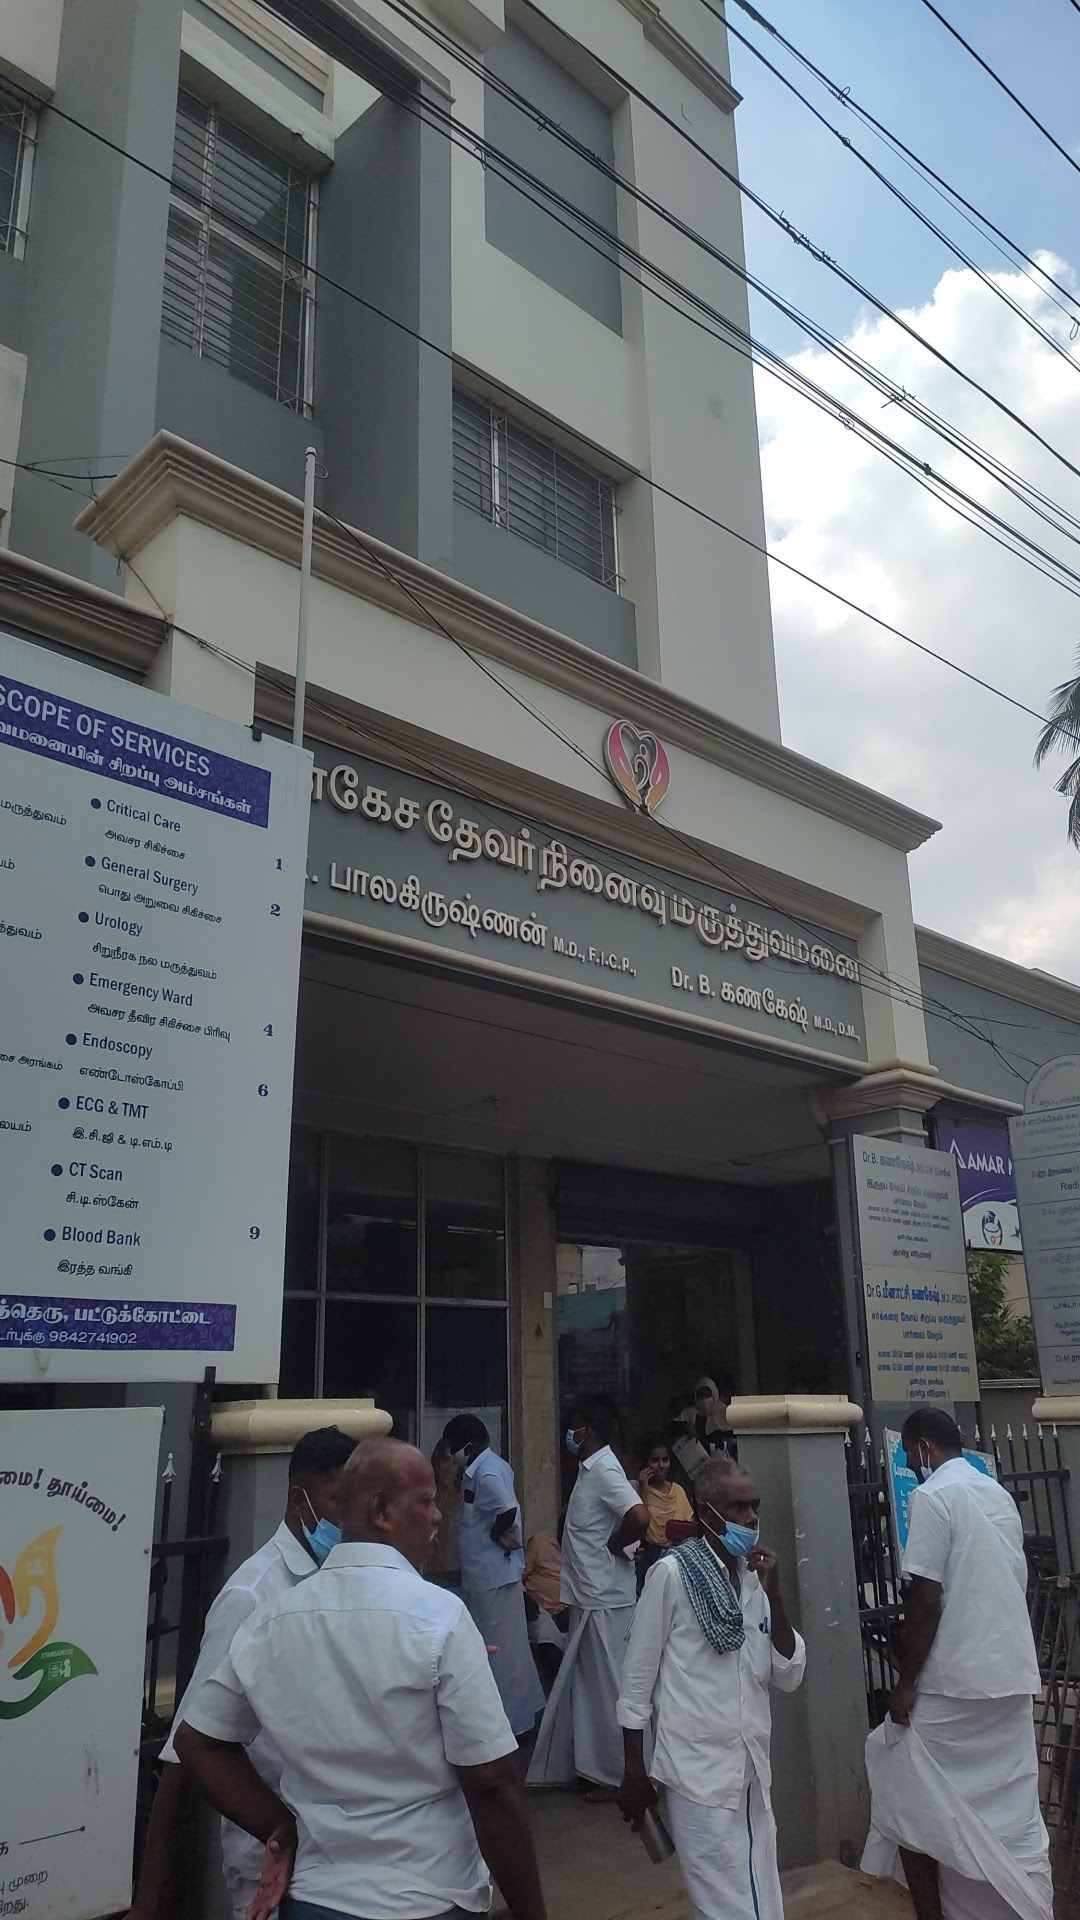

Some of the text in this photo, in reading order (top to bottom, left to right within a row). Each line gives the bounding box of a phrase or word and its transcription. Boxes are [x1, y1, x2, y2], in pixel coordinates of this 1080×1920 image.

[76, 714, 107, 739] OF
[110, 726, 210, 777] SERVICES
[108, 757, 160, 787] சிறப்பு
[164, 777, 252, 815] அம்சங்கள்
[106, 799, 181, 832] Critical Care
[105, 830, 186, 859] அவசர சிகிச்சை
[101, 856, 199, 896] General Surgery
[275, 858, 283, 871] 1
[98, 884, 222, 924] பொது அறுவை சிகிச்சை
[270, 903, 281, 917] 2
[330, 862, 548, 947] பாலகிருஷ்ணன்
[95, 911, 143, 937] Urology
[92, 942, 218, 980] சிறுநீரக நல மருத்துவம்
[90, 972, 193, 1006] Emergency Ward
[671, 966, 694, 990] Dr.
[698, 974, 715, 997] B.
[720, 981, 808, 1033] கணகேஷ்
[88, 1003, 231, 1043] அவசர தீவிர சிகிச்சை பிரிவு
[263, 1024, 274, 1037] 4
[82, 1033, 153, 1059] Endoscopy
[18, 1056, 63, 1070] அரங்கம்
[79, 1066, 184, 1091] எண்டோஸ்கோப்பி
[257, 1083, 269, 1097] 6
[76, 1096, 149, 1119] ECG & TMT
[117, 1134, 126, 1145] &
[69, 1162, 123, 1181] CT Scan
[967, 1151, 1006, 1175] AMAR
[62, 1226, 141, 1246] Blood Bank
[250, 1226, 260, 1239] 9
[57, 1259, 133, 1277] இரத்த வங்கி
[74, 1304, 211, 1325] பட்டுக்கோட்டை
[49, 1330, 137, 1344] 9842741902
[47, 1477, 127, 1532] தூய்மை!
[9, 1870, 48, 1892] முறை
